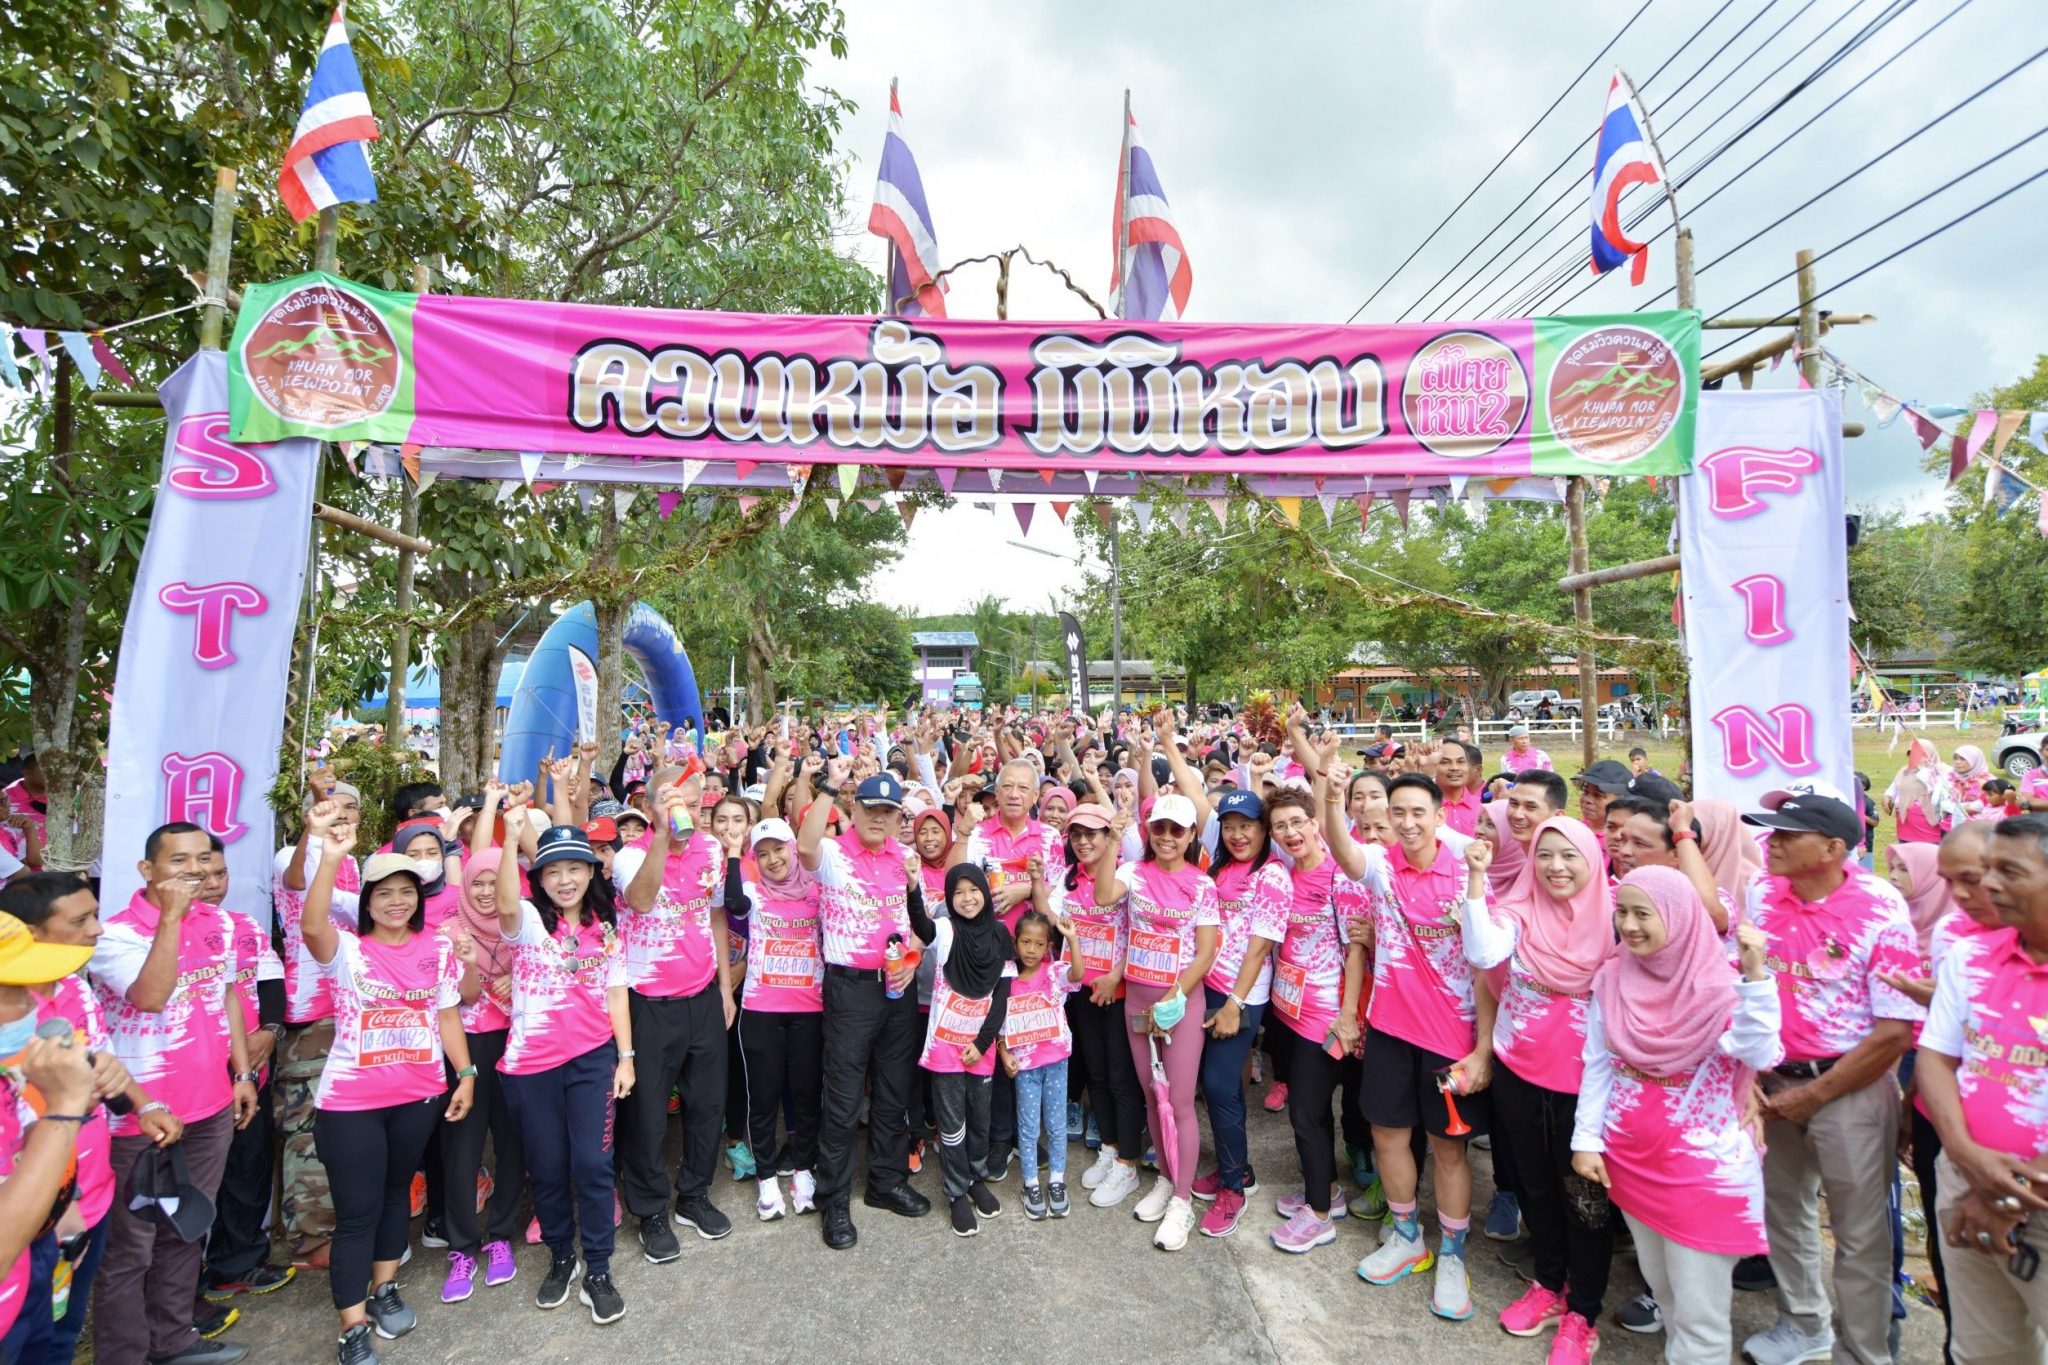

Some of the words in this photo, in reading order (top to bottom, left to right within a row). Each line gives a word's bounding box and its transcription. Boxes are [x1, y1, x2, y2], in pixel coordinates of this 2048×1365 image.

[287, 359, 339, 377] KHUAN
[568, 318, 1007, 453] ควนหม้อ
[1011, 329, 1391, 456] มินิหอบ
[1581, 400, 1624, 413] KHUAN
[1629, 400, 1656, 413] MOR
[1572, 414, 1655, 429] VIEWPOINT
[368, 1009, 421, 1029] Coca-Cola
[601, 1090, 615, 1153] ARMANI
